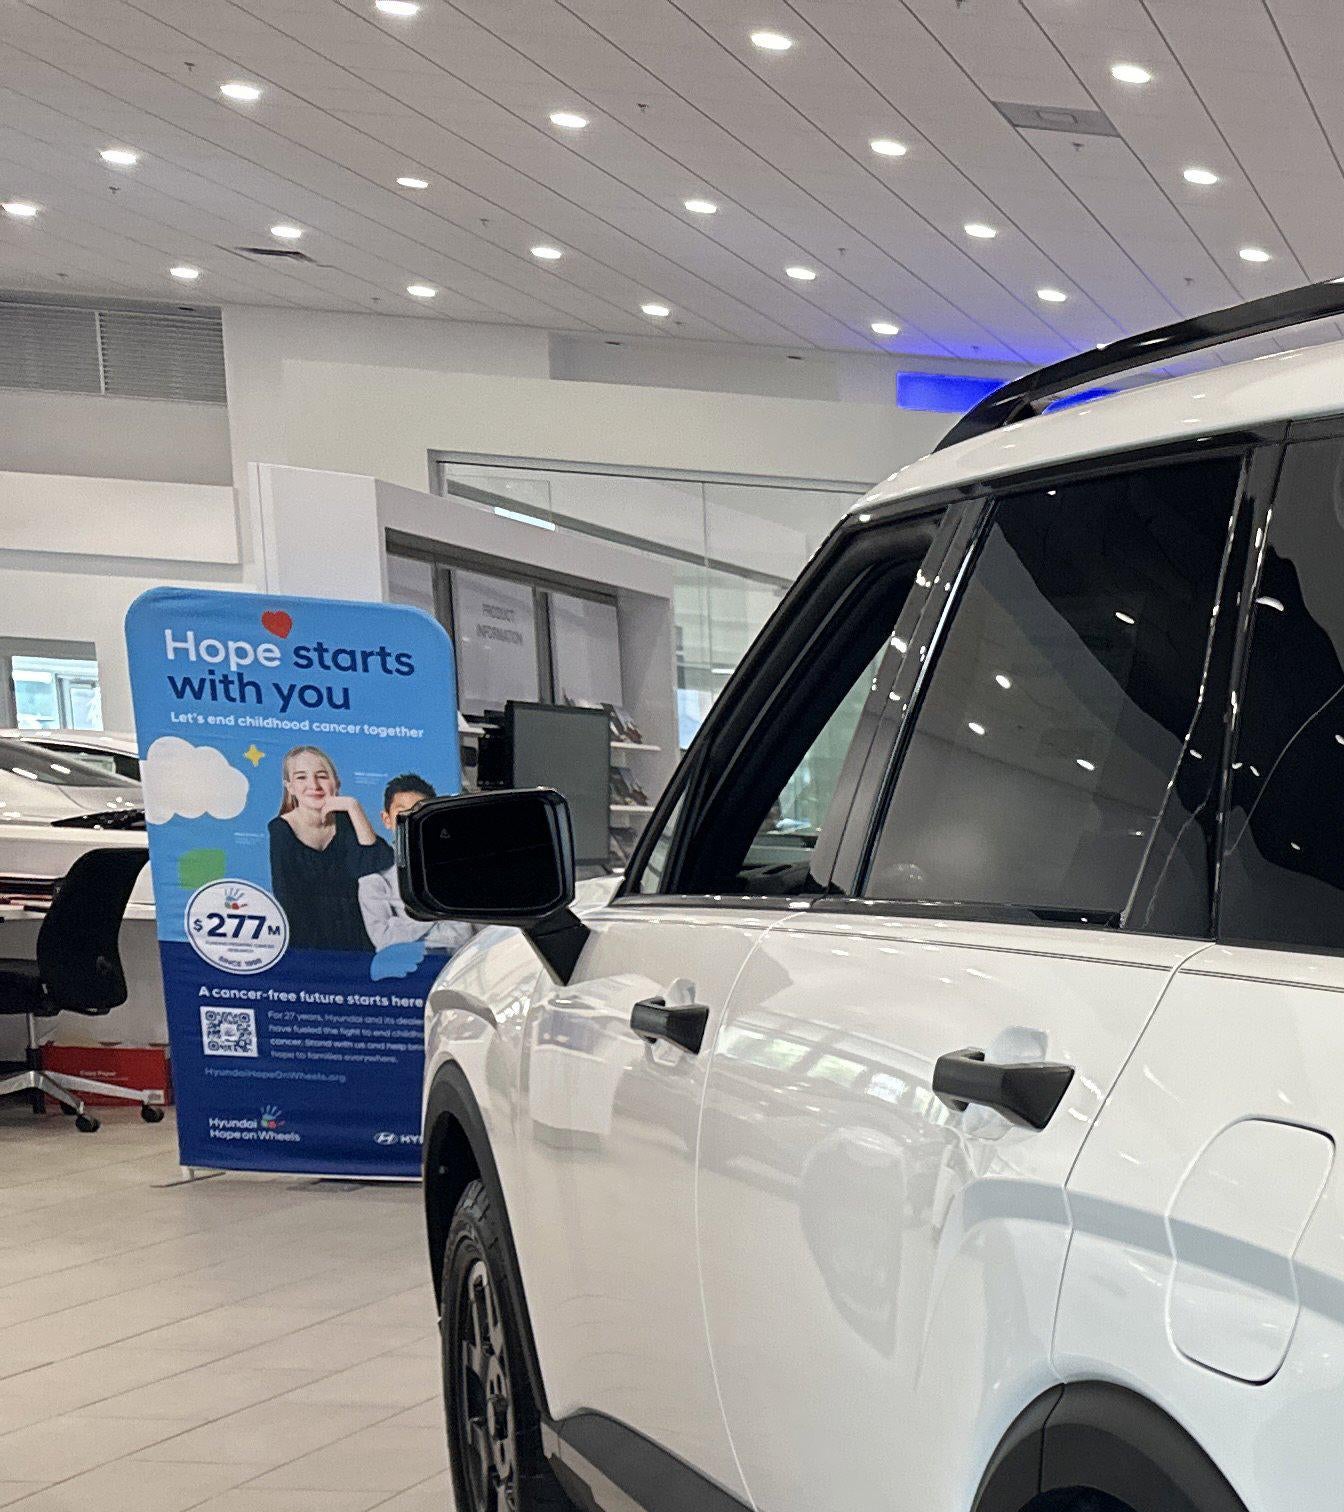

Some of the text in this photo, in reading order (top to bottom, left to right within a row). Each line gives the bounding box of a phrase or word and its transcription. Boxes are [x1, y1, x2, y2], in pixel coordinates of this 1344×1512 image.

[164, 629, 415, 677] Hope starts
[167, 669, 351, 713] with you
[170, 712, 424, 739] Let's end childhood cancer together
[198, 985, 423, 1008] A cancer-free future starts here
[208, 1117, 257, 1129] Hyundai
[209, 1128, 300, 1142] Hope on Wheels
